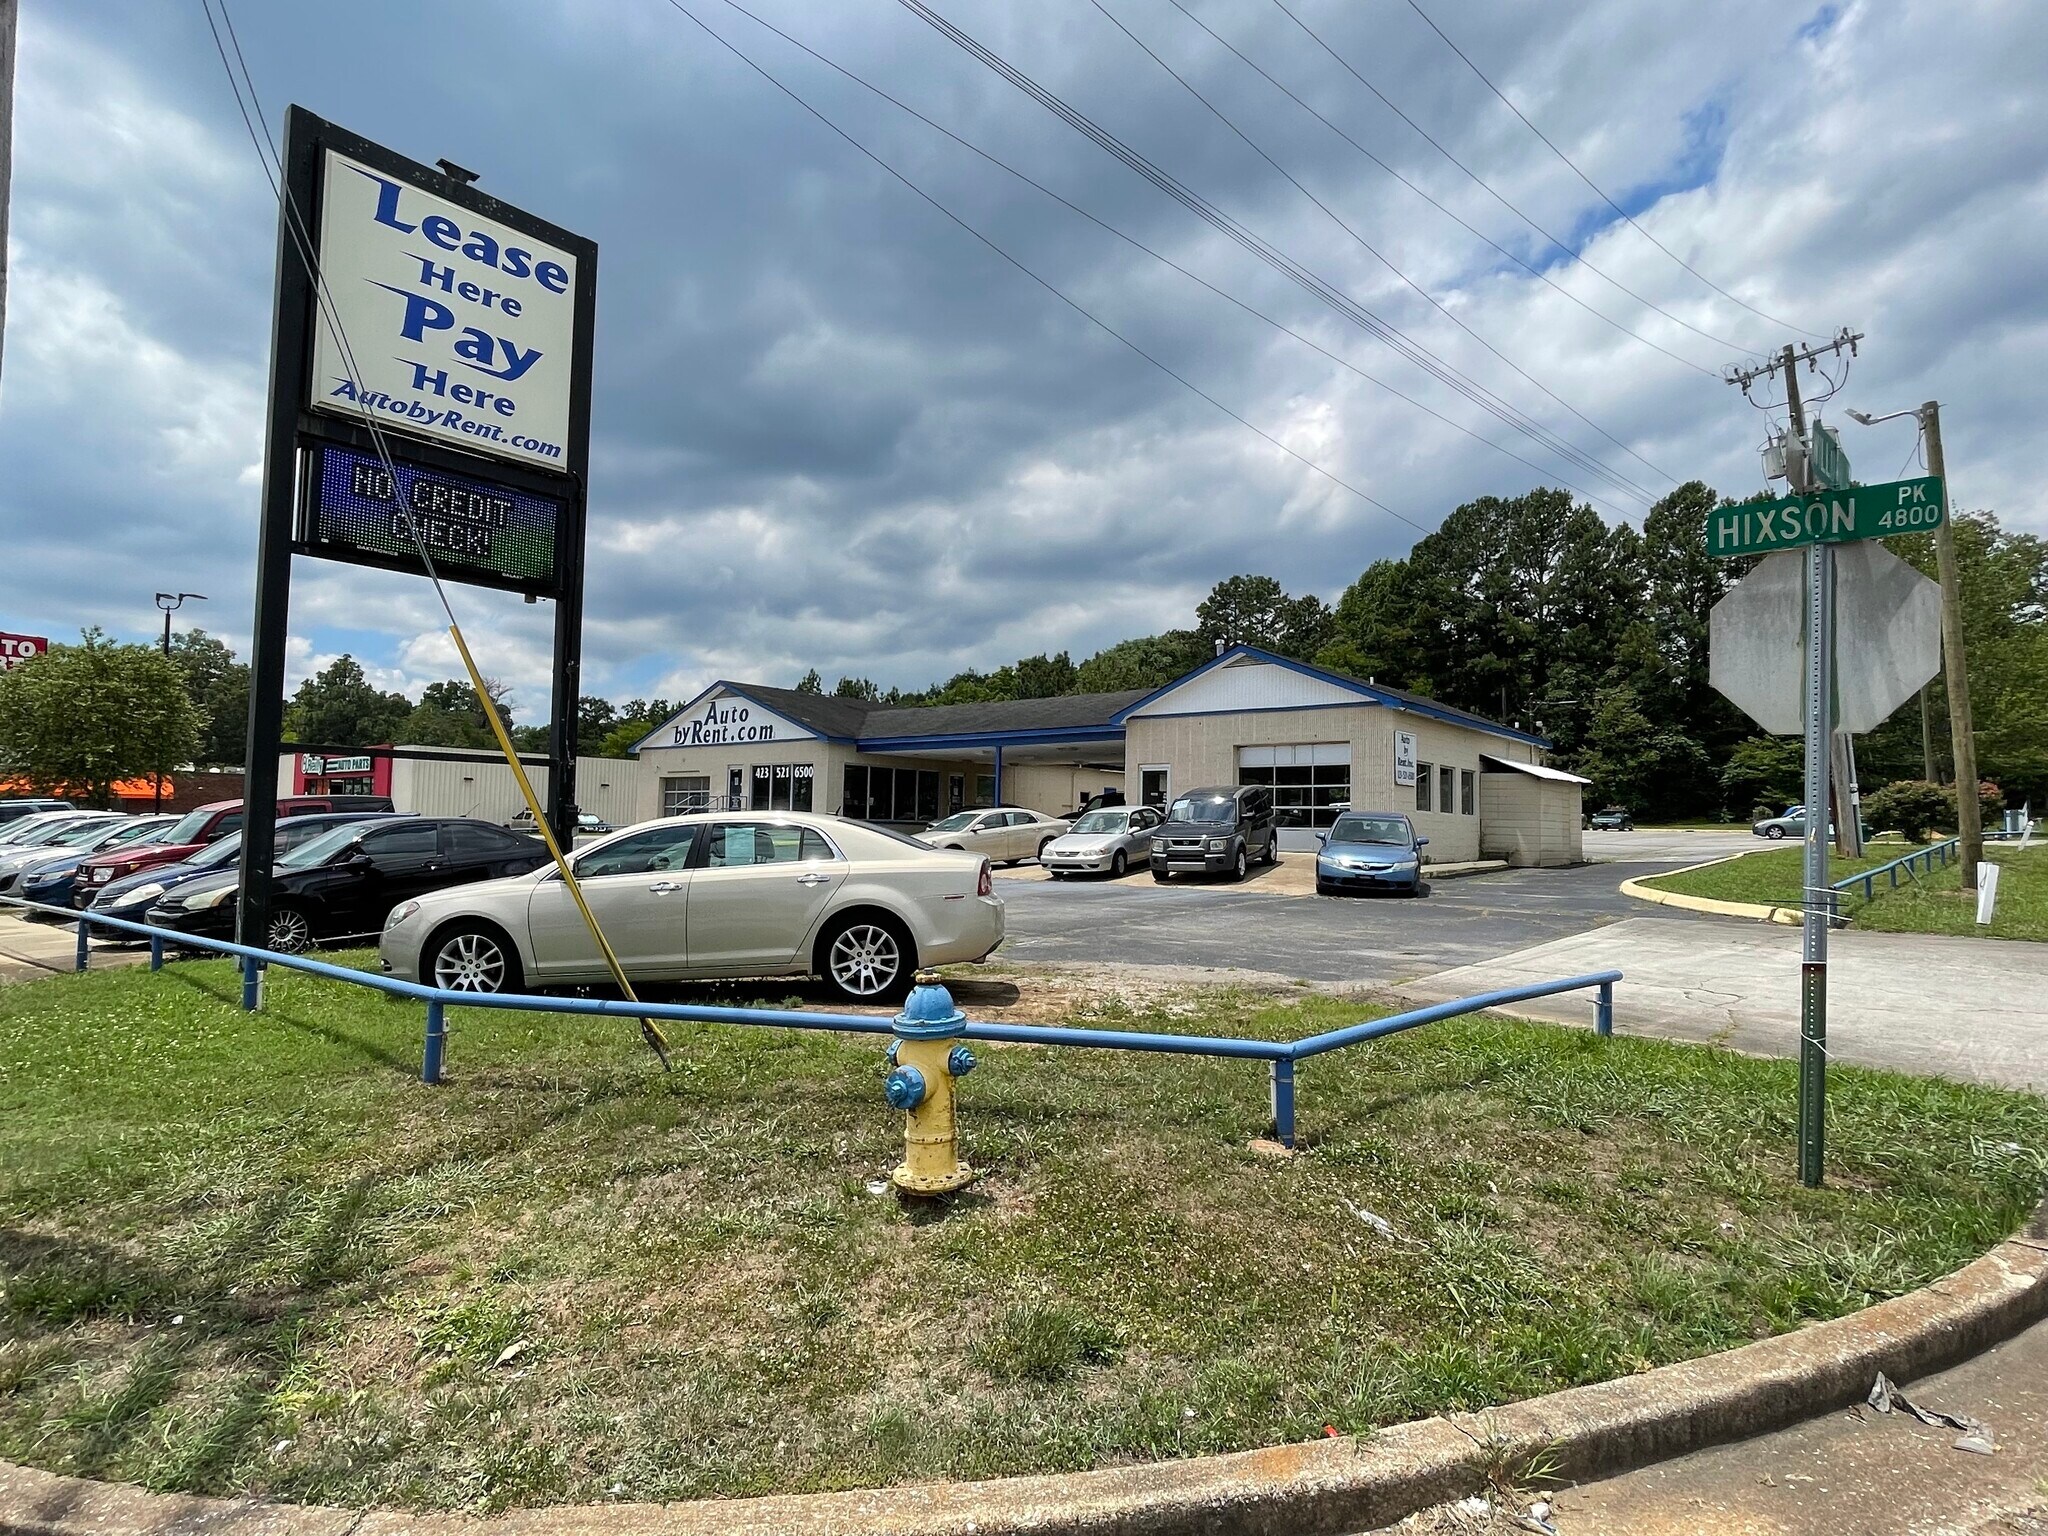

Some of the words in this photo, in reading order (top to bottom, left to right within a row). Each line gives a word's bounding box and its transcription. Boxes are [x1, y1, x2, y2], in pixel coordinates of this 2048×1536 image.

[337, 161, 569, 295] Lease
[400, 251, 522, 318] Here
[363, 278, 544, 382] Pay
[392, 356, 516, 417] Here
[329, 376, 561, 458] AutobyRent.com
[354, 466, 392, 499] NO
[413, 481, 511, 525] CREDIT
[1877, 504, 1939, 529] 4800
[1897, 483, 1926, 505] PK
[1718, 498, 1856, 549] HIXSON
[704, 701, 749, 726] Auto
[352, 758, 369, 769] PARTS
[755, 766, 769, 778] 423
[776, 766, 790, 778] 521
[794, 765, 814, 778] 6500
